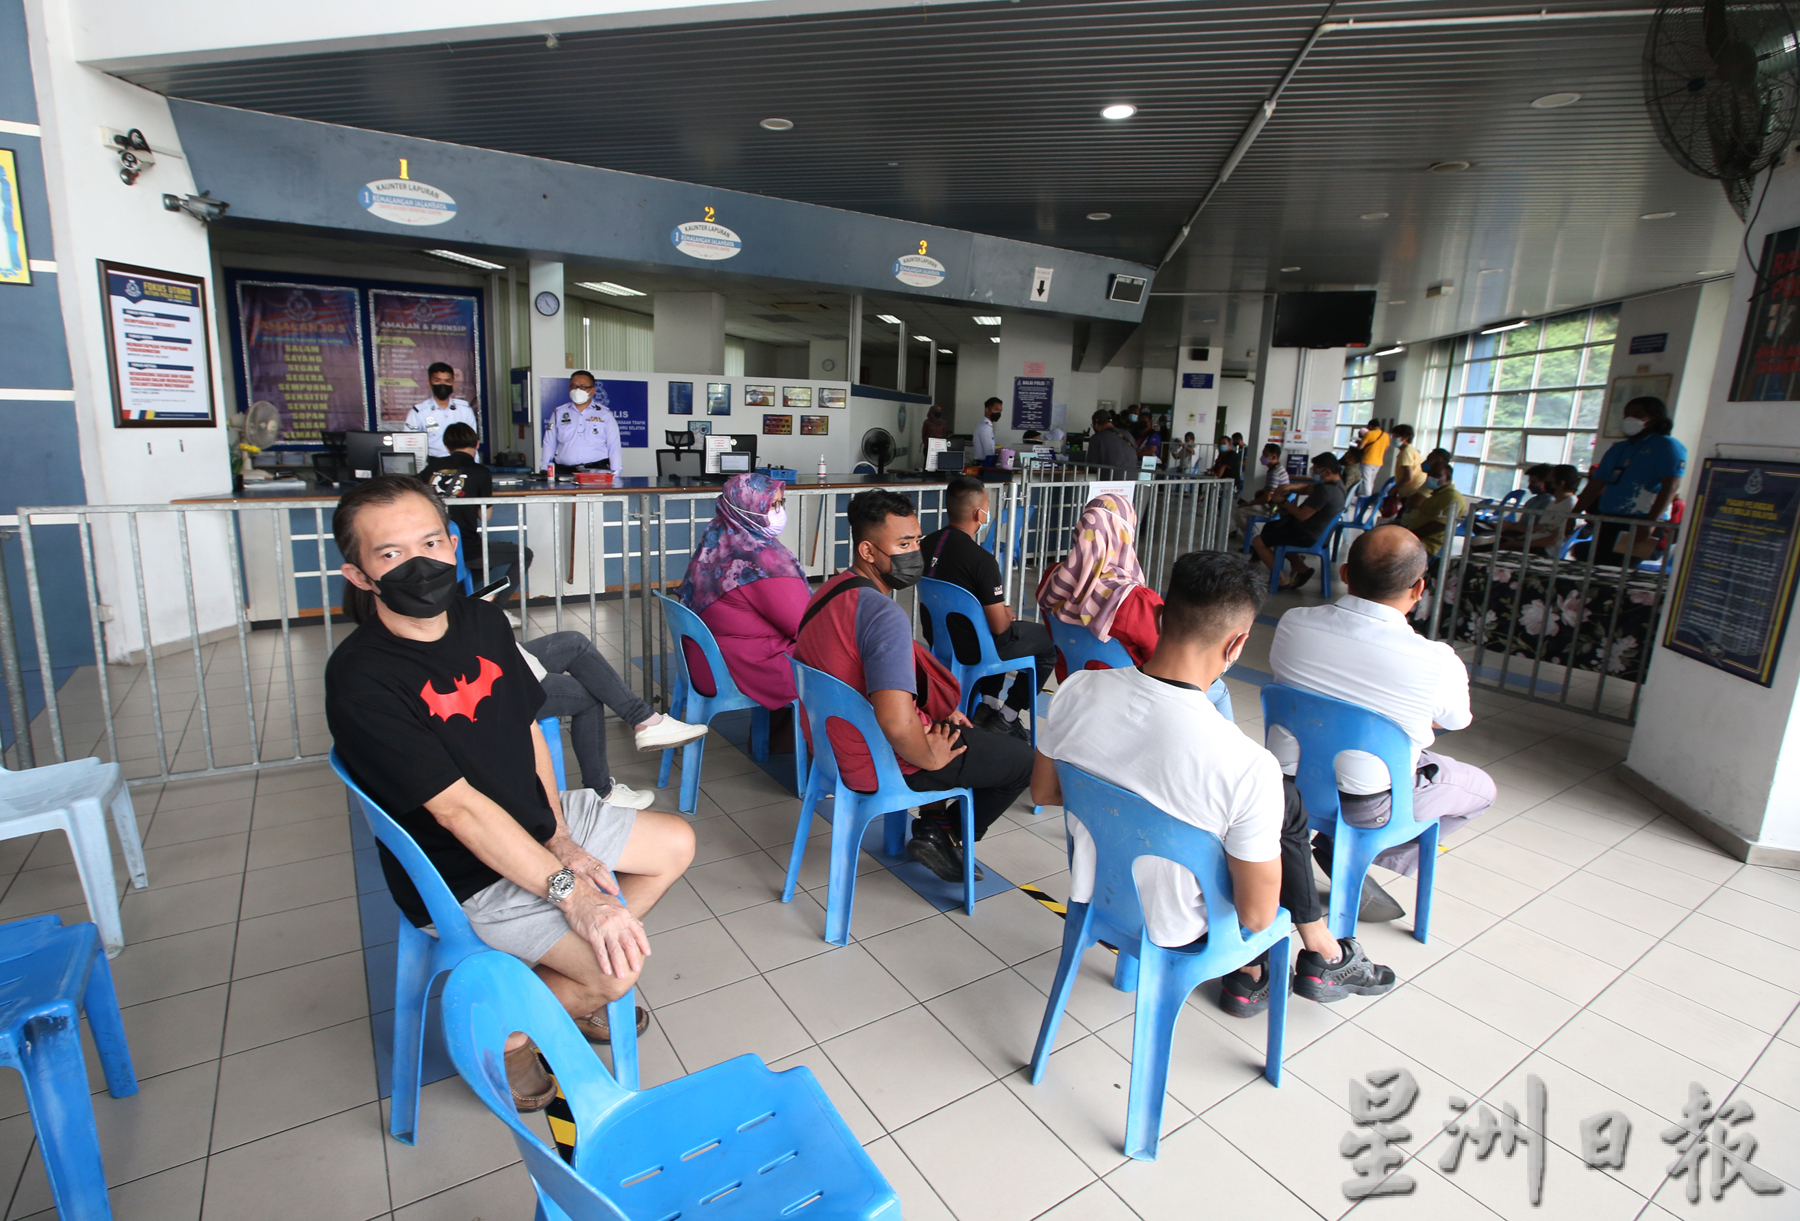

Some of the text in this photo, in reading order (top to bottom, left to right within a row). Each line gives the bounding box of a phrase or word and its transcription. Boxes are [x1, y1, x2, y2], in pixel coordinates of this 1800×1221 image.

[399, 158, 409, 180] 1
[376, 182, 439, 198] KAUNTER LAPURAN
[364, 192, 370, 204] 1
[372, 194, 414, 206] KEMALANGAN
[704, 206, 715, 222] 2
[675, 232, 679, 242] 1
[708, 226, 730, 238] LAPURAN
[918, 240, 927, 255] 3
[143, 282, 166, 292] FOKUS
[260, 320, 318, 332] AMALAN
[381, 322, 419, 330] AMALAN
[285, 345, 320, 353] SALAM
